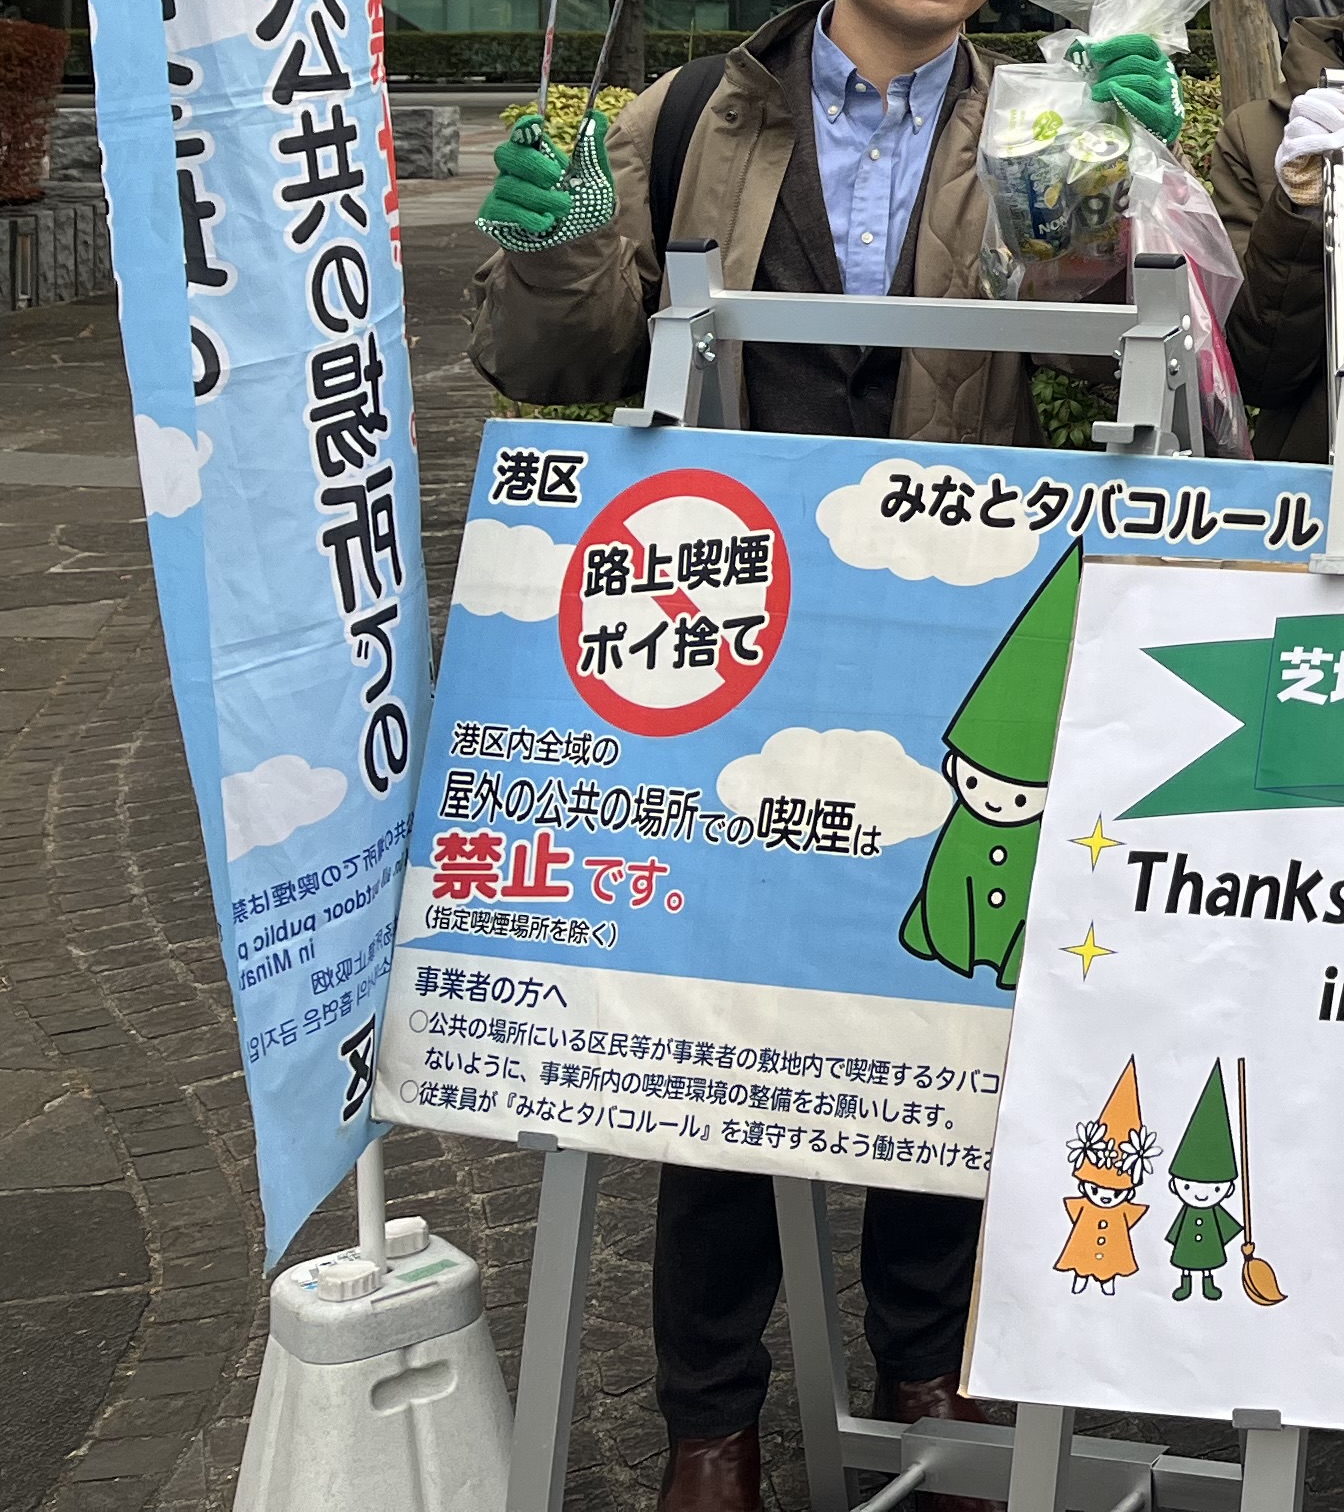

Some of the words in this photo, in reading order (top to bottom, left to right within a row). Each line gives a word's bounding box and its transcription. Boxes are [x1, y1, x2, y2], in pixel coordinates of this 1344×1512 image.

[492, 450, 584, 503] 港区
[879, 471, 1320, 547] みなとタバコルール
[583, 534, 771, 598] 路上喫煙
[580, 613, 766, 676] ポイ捨て
[450, 722, 620, 767] 港区内全域の
[440, 770, 883, 857] 屋外の公共の場所での喫煙は
[432, 831, 685, 913] 禁止です。
[415, 965, 568, 1008] 事業者の方へ
[424, 1046, 954, 1130] ないように、事業所内の喫煙環境の整備をお願いします。
